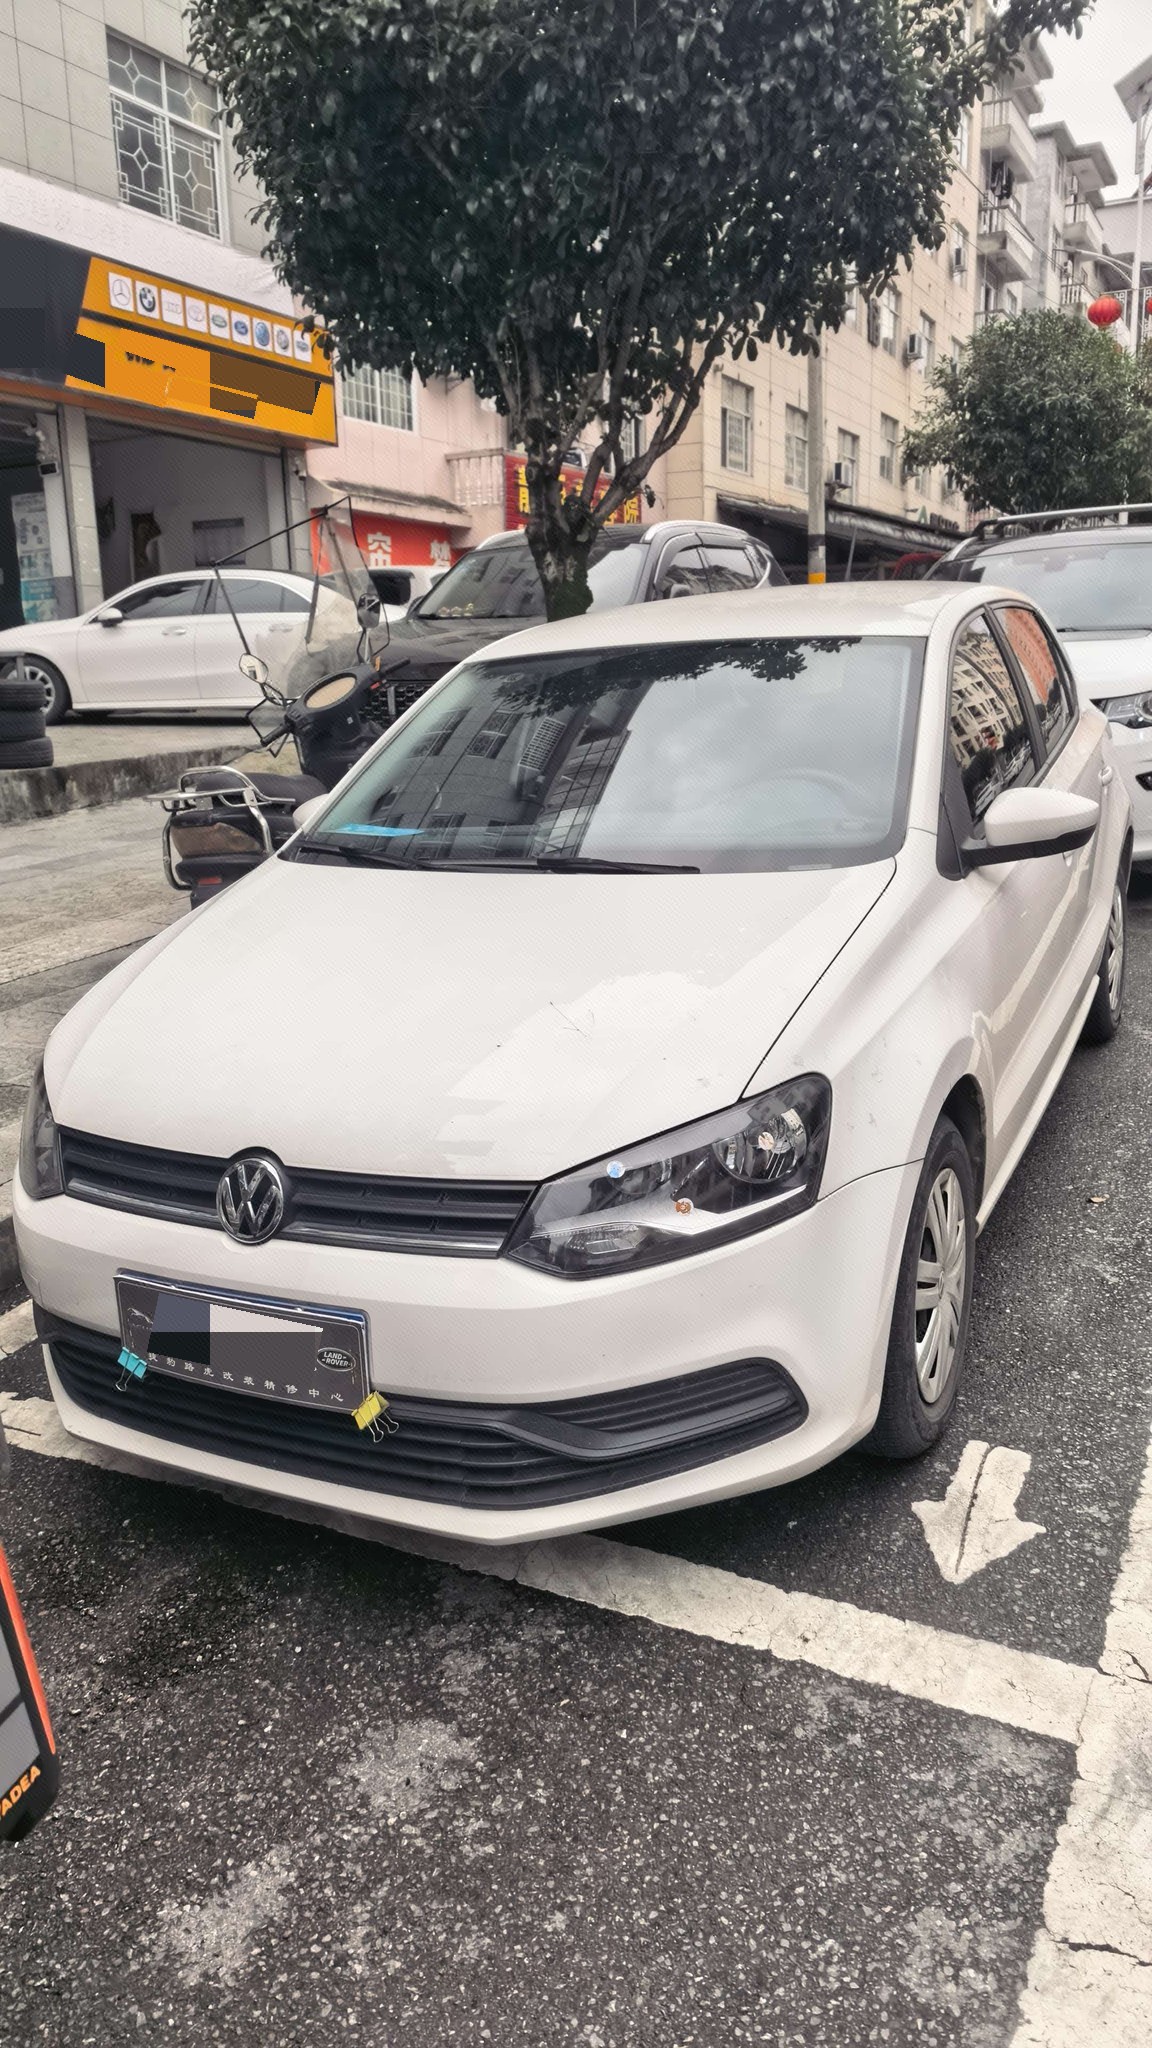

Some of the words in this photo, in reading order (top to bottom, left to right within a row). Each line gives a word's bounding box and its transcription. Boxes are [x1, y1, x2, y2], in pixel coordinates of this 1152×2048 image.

[323, 1351, 343, 1361] LAND
[326, 1358, 349, 1368] ROVER
[0, 1765, 41, 1818] ADEA
